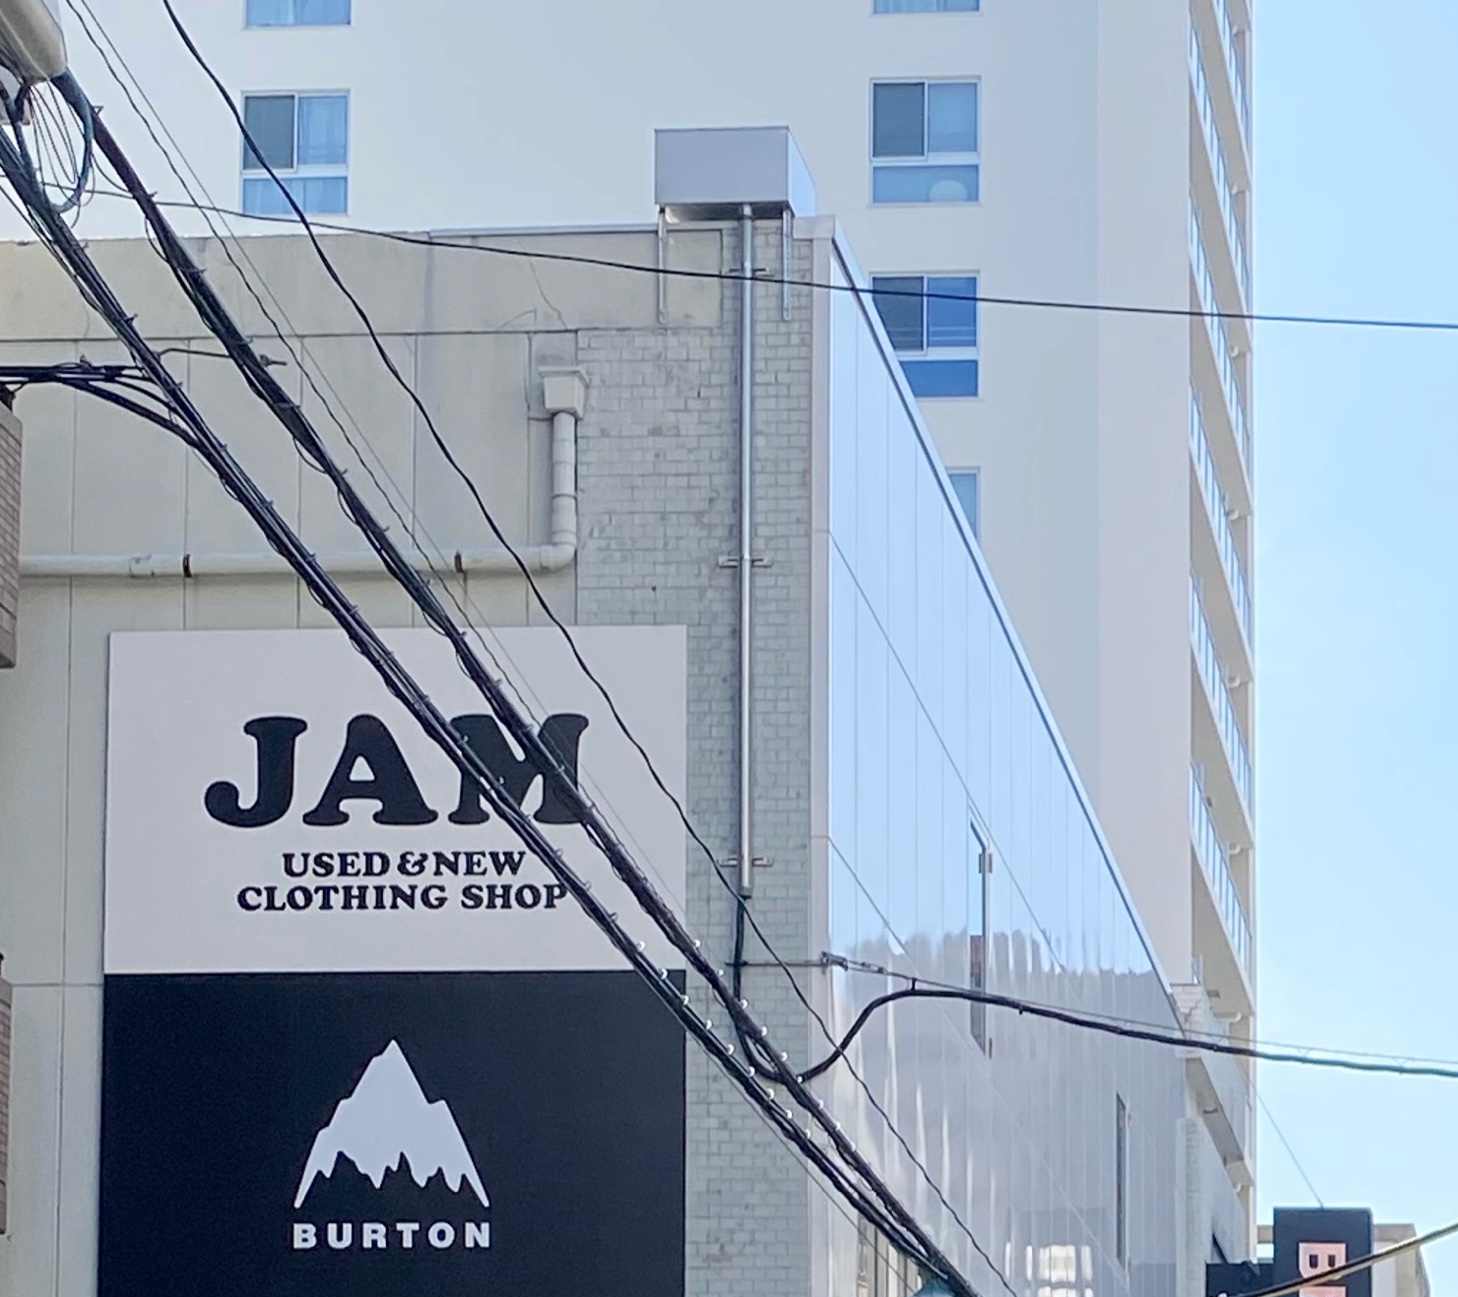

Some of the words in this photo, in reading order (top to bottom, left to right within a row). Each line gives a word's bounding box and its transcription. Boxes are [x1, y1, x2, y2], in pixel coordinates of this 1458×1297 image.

[204, 713, 590, 828] JAM
[236, 884, 449, 912] CLOTHING
[461, 883, 568, 911] SHOP
[293, 1222, 491, 1249] BURTON
